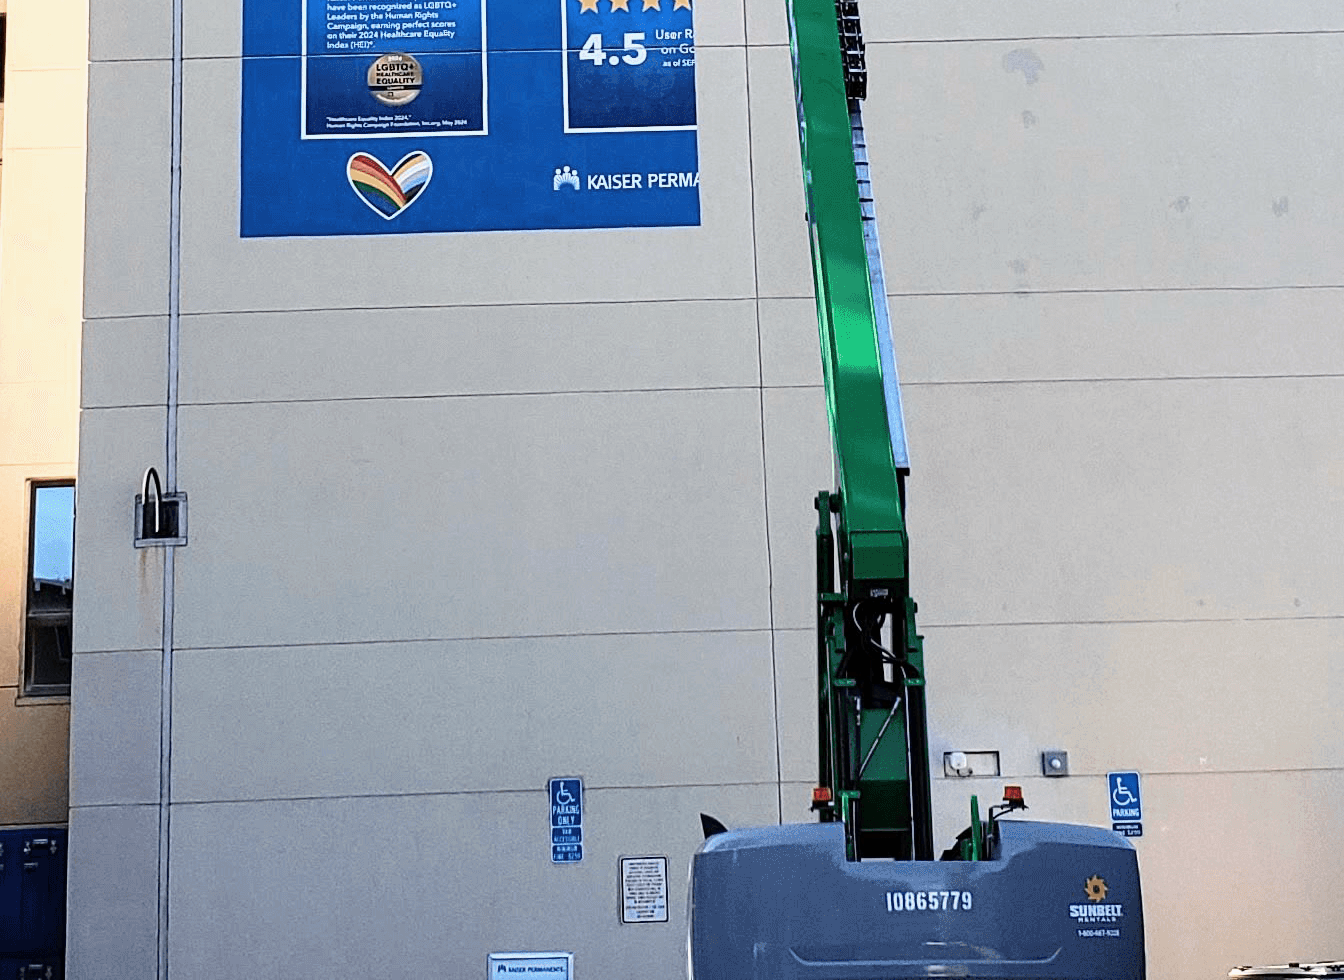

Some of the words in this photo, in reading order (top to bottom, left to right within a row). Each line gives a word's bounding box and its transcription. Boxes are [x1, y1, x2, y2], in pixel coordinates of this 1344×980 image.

[369, 3, 412, 11] recognized
[360, 13, 369, 21] by
[415, 12, 439, 20] Rights
[327, 23, 368, 31] Campaign,
[371, 22, 400, 30] earning
[402, 21, 429, 29] perfect
[424, 30, 455, 38] Equality
[656, 29, 682, 40] User
[579, 33, 647, 65] 4.5
[660, 46, 676, 54] on
[588, 174, 642, 190] KAISER
[553, 805, 579, 815] PARKING
[1113, 808, 1139, 817] PARKING
[558, 816, 575, 826] ONLY
[887, 892, 972, 911] 10865779
[1070, 905, 1122, 917] SUNBELT
